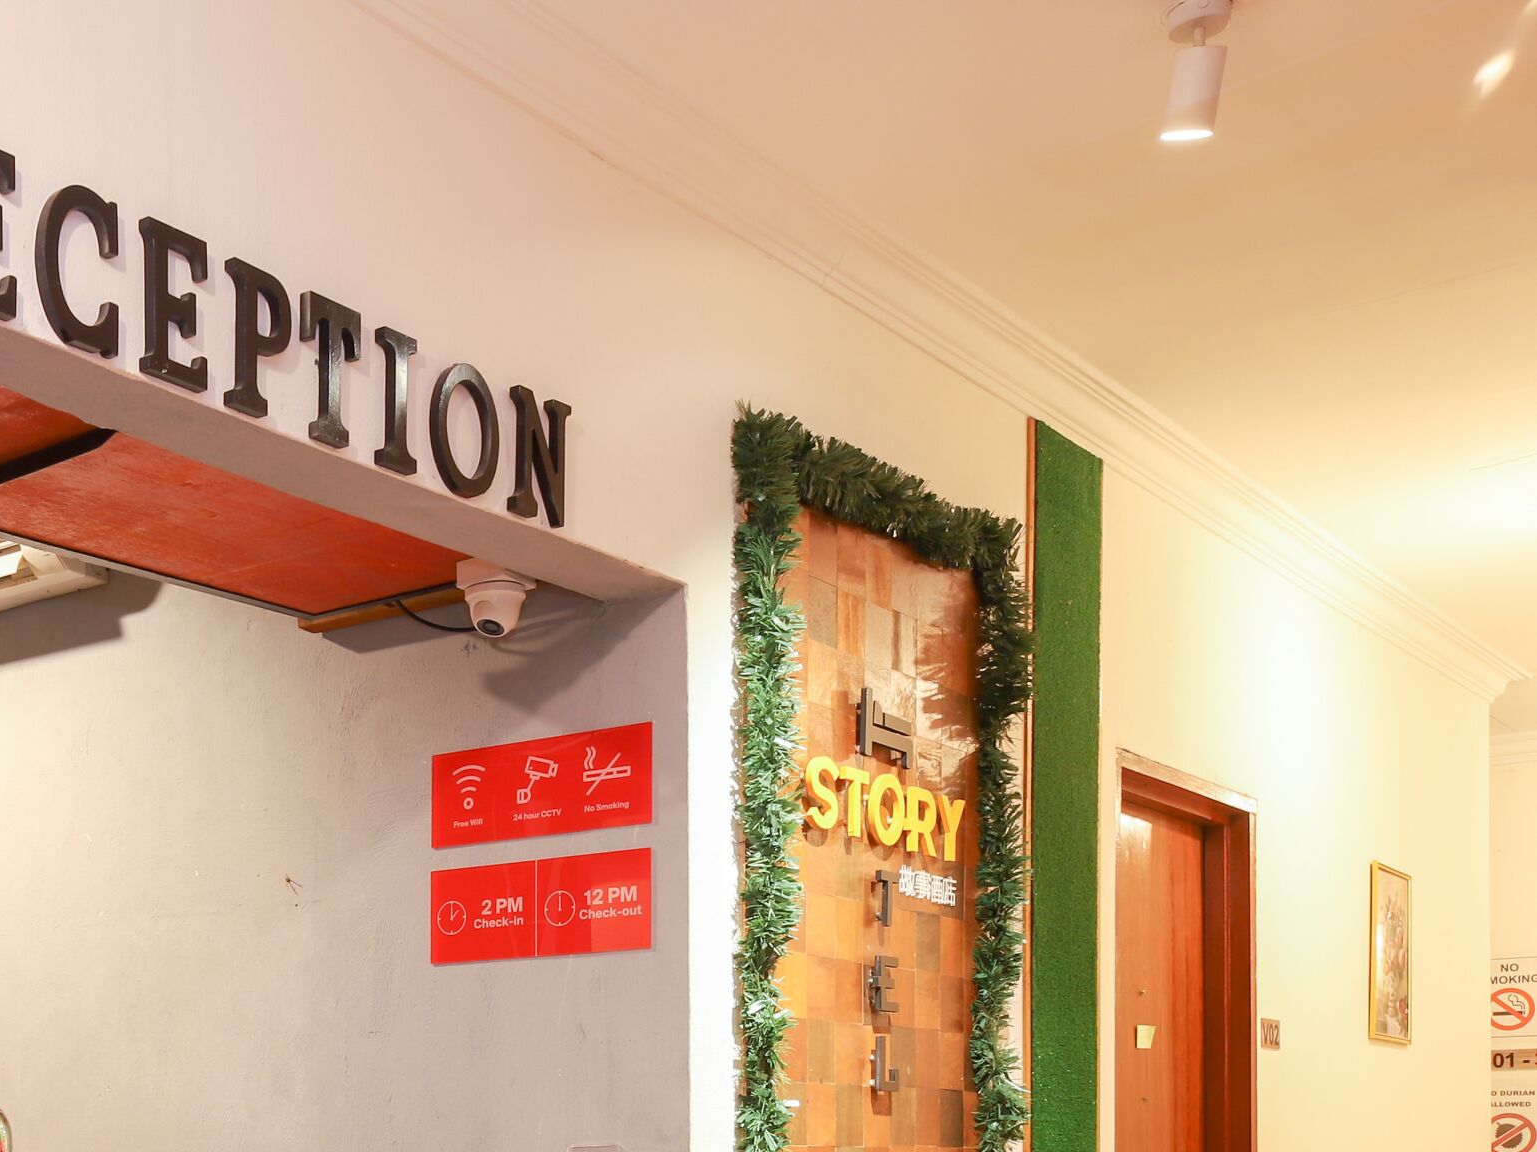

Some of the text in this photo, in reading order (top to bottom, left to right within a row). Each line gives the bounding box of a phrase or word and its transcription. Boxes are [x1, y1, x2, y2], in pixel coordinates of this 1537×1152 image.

[584, 801, 630, 813] No Smoking
[804, 755, 965, 862] STORY
[513, 808, 562, 822] 24 hour CCTV
[453, 820, 469, 828] Free
[583, 885, 637, 906] 12 PM
[481, 896, 523, 915] 2 PM
[579, 904, 643, 920] Check-out
[473, 915, 524, 930] Check-in
[1500, 963, 1519, 972] NO
[1490, 974, 1537, 985] MOKING
[1262, 1022, 1280, 1046] V02
